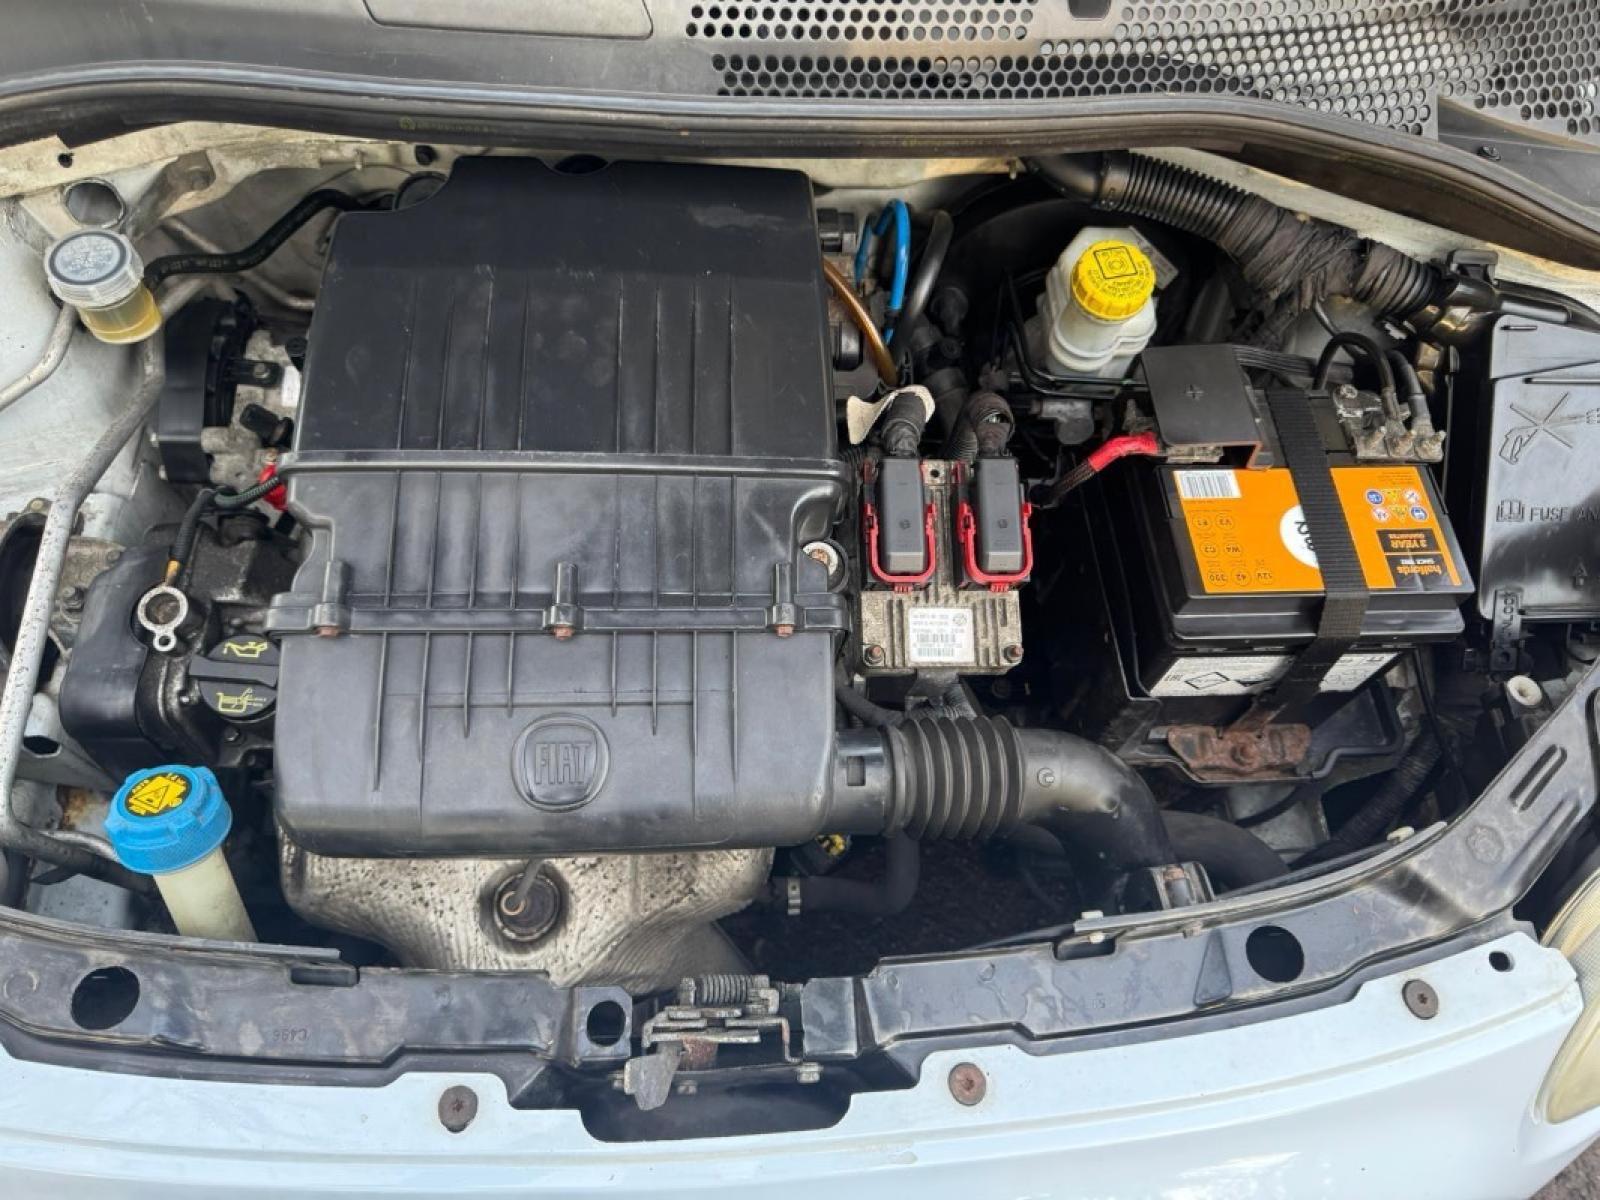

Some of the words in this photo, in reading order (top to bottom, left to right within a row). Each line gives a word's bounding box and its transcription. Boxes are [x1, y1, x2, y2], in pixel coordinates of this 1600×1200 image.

[1530, 507, 1568, 521] FUSE
[1391, 539, 1420, 549] YEAR
[1396, 565, 1442, 576] halfords
[535, 741, 591, 784] FIAT
